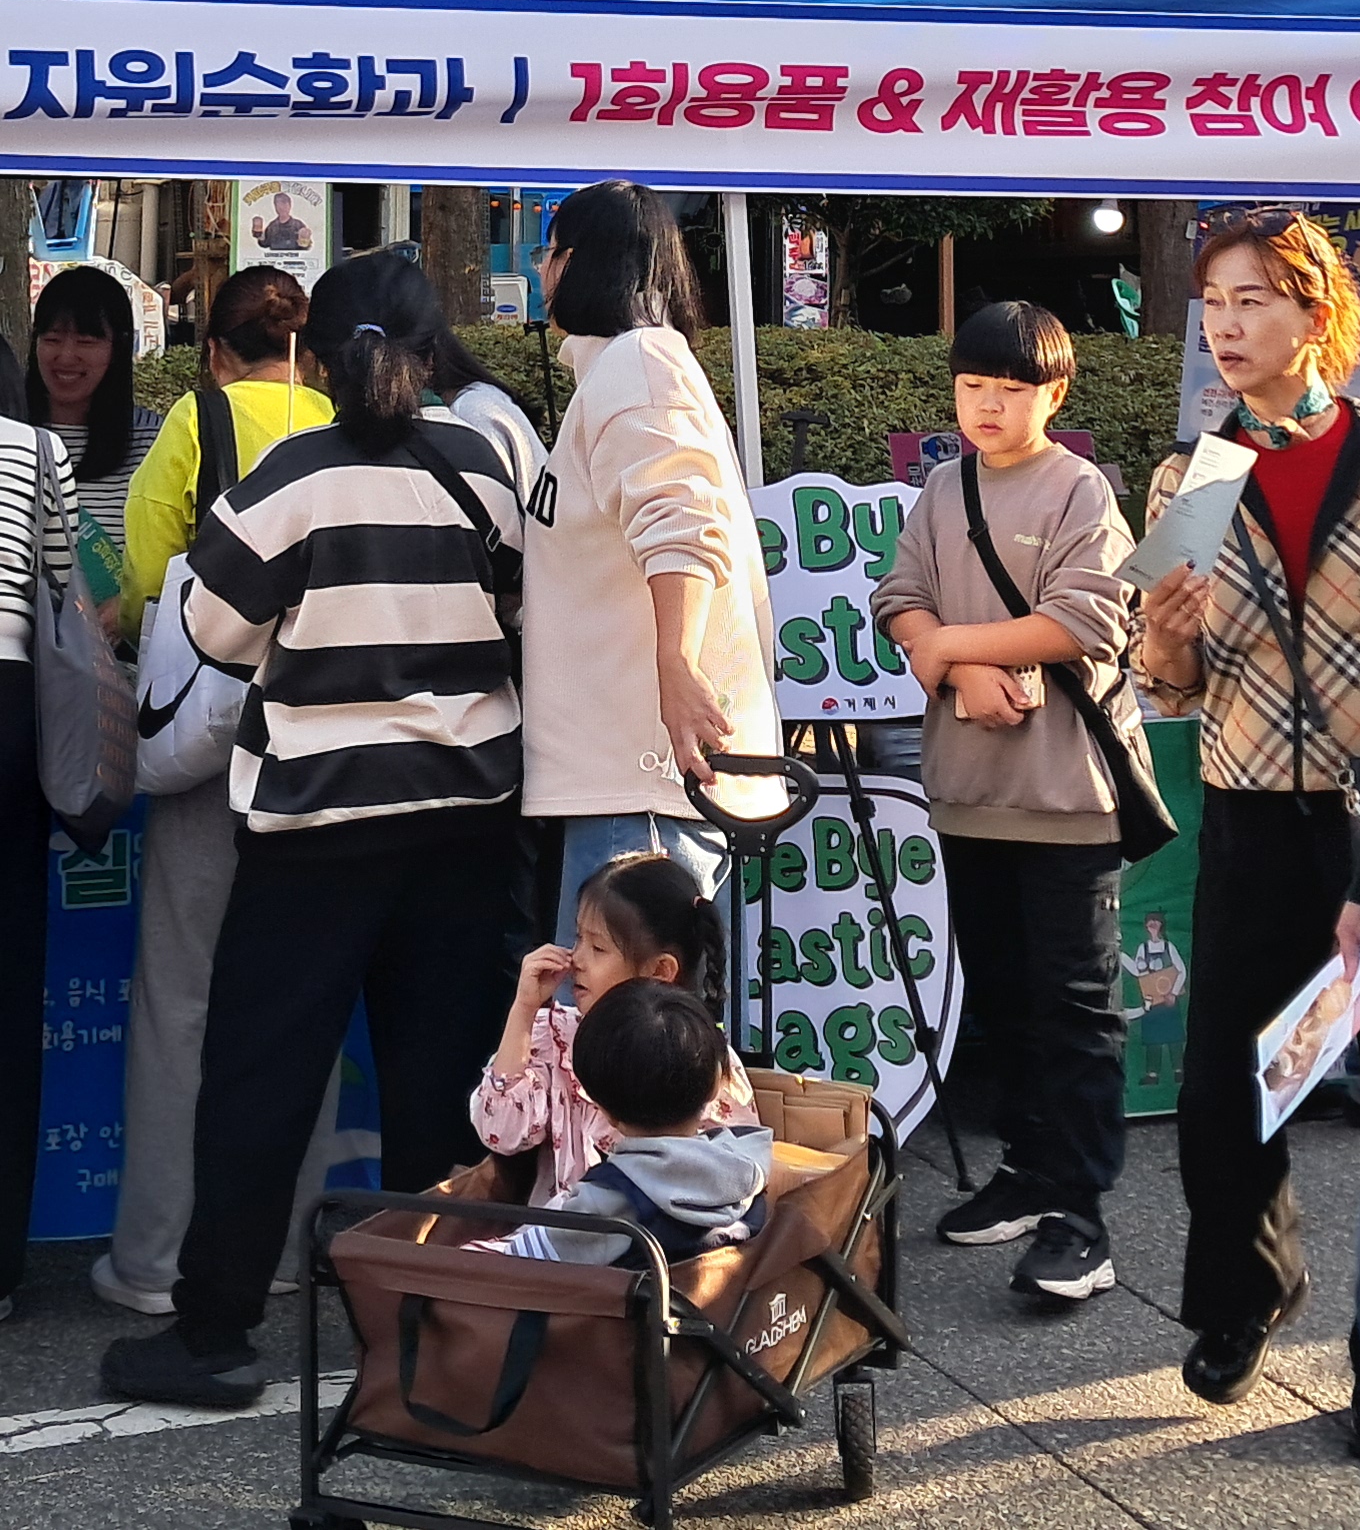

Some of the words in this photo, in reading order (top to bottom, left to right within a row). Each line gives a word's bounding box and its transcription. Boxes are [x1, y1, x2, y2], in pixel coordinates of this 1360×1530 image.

[568, 59, 848, 128] 1회용품
[857, 67, 923, 134] &
[939, 67, 1173, 138] 재활용
[1184, 71, 1342, 140] 참여
[748, 909, 937, 999] astic
[749, 1002, 916, 1092] ags
